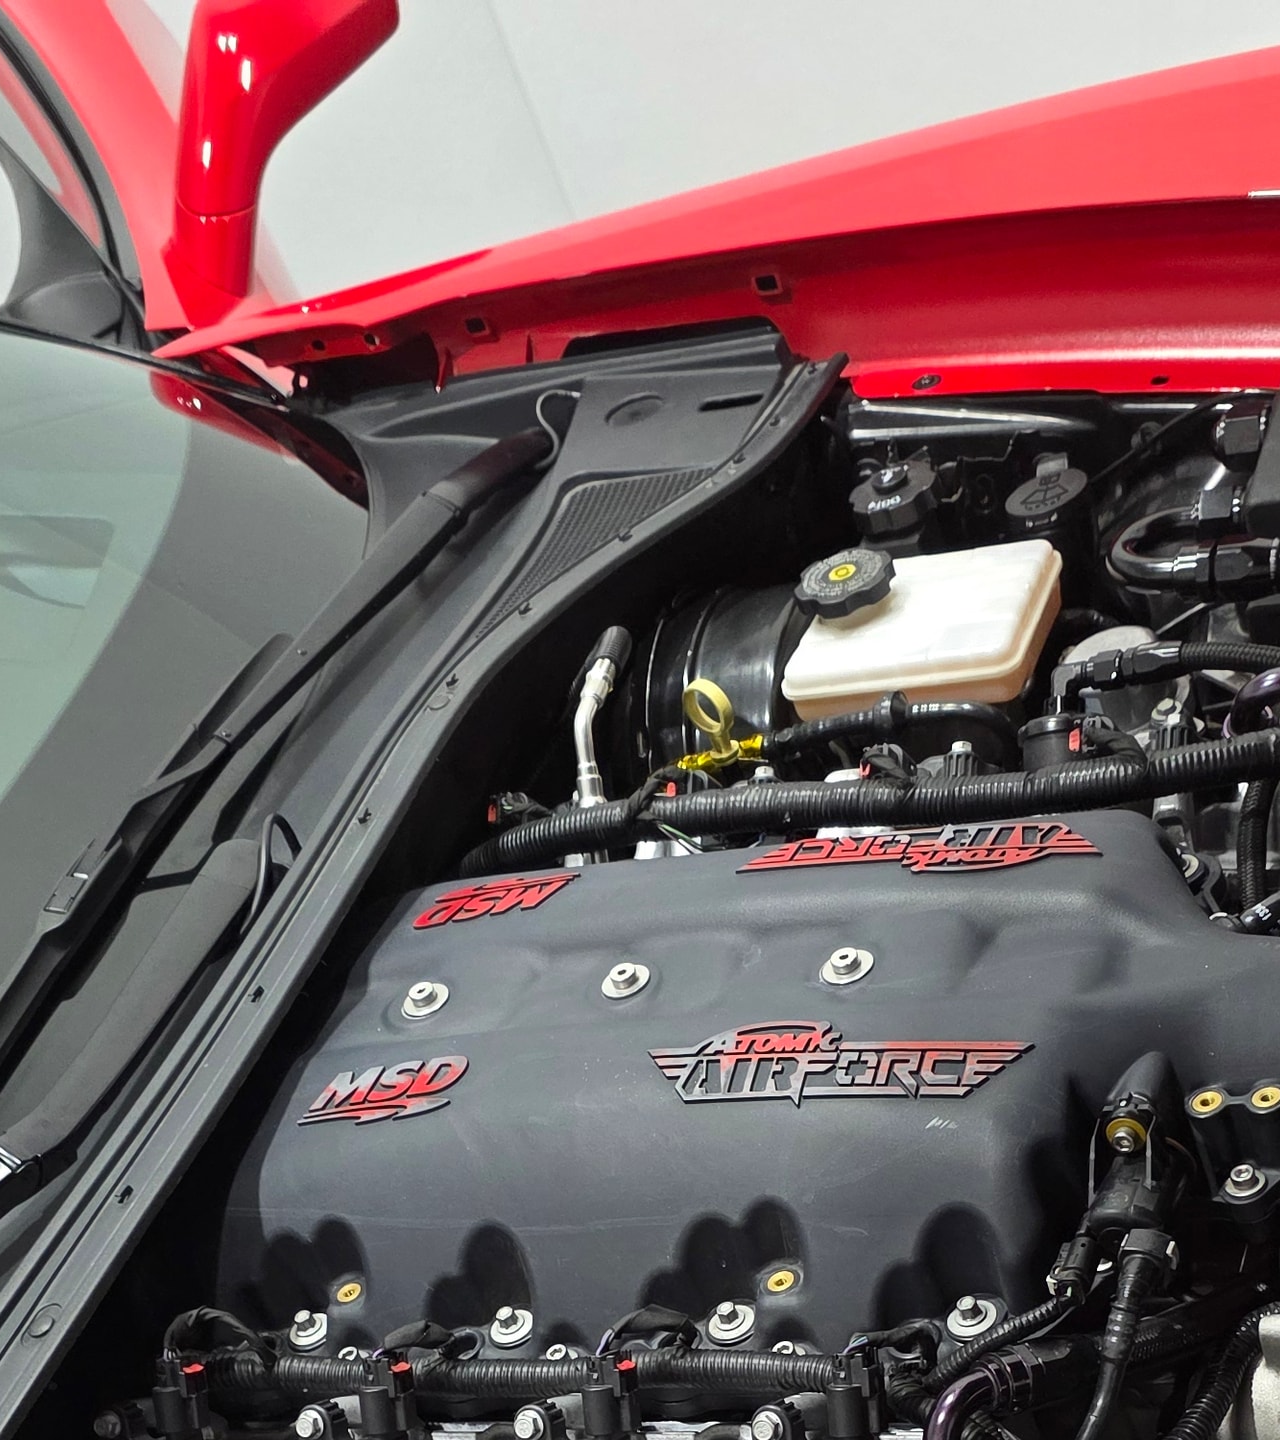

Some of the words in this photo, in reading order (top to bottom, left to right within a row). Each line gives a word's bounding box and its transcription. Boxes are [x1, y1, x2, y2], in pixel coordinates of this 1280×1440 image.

[413, 878, 574, 930] MSD
[695, 1022, 843, 1055] ATOMIC
[308, 1055, 470, 1112] MSD
[670, 1046, 1025, 1107] AIRFORCE
